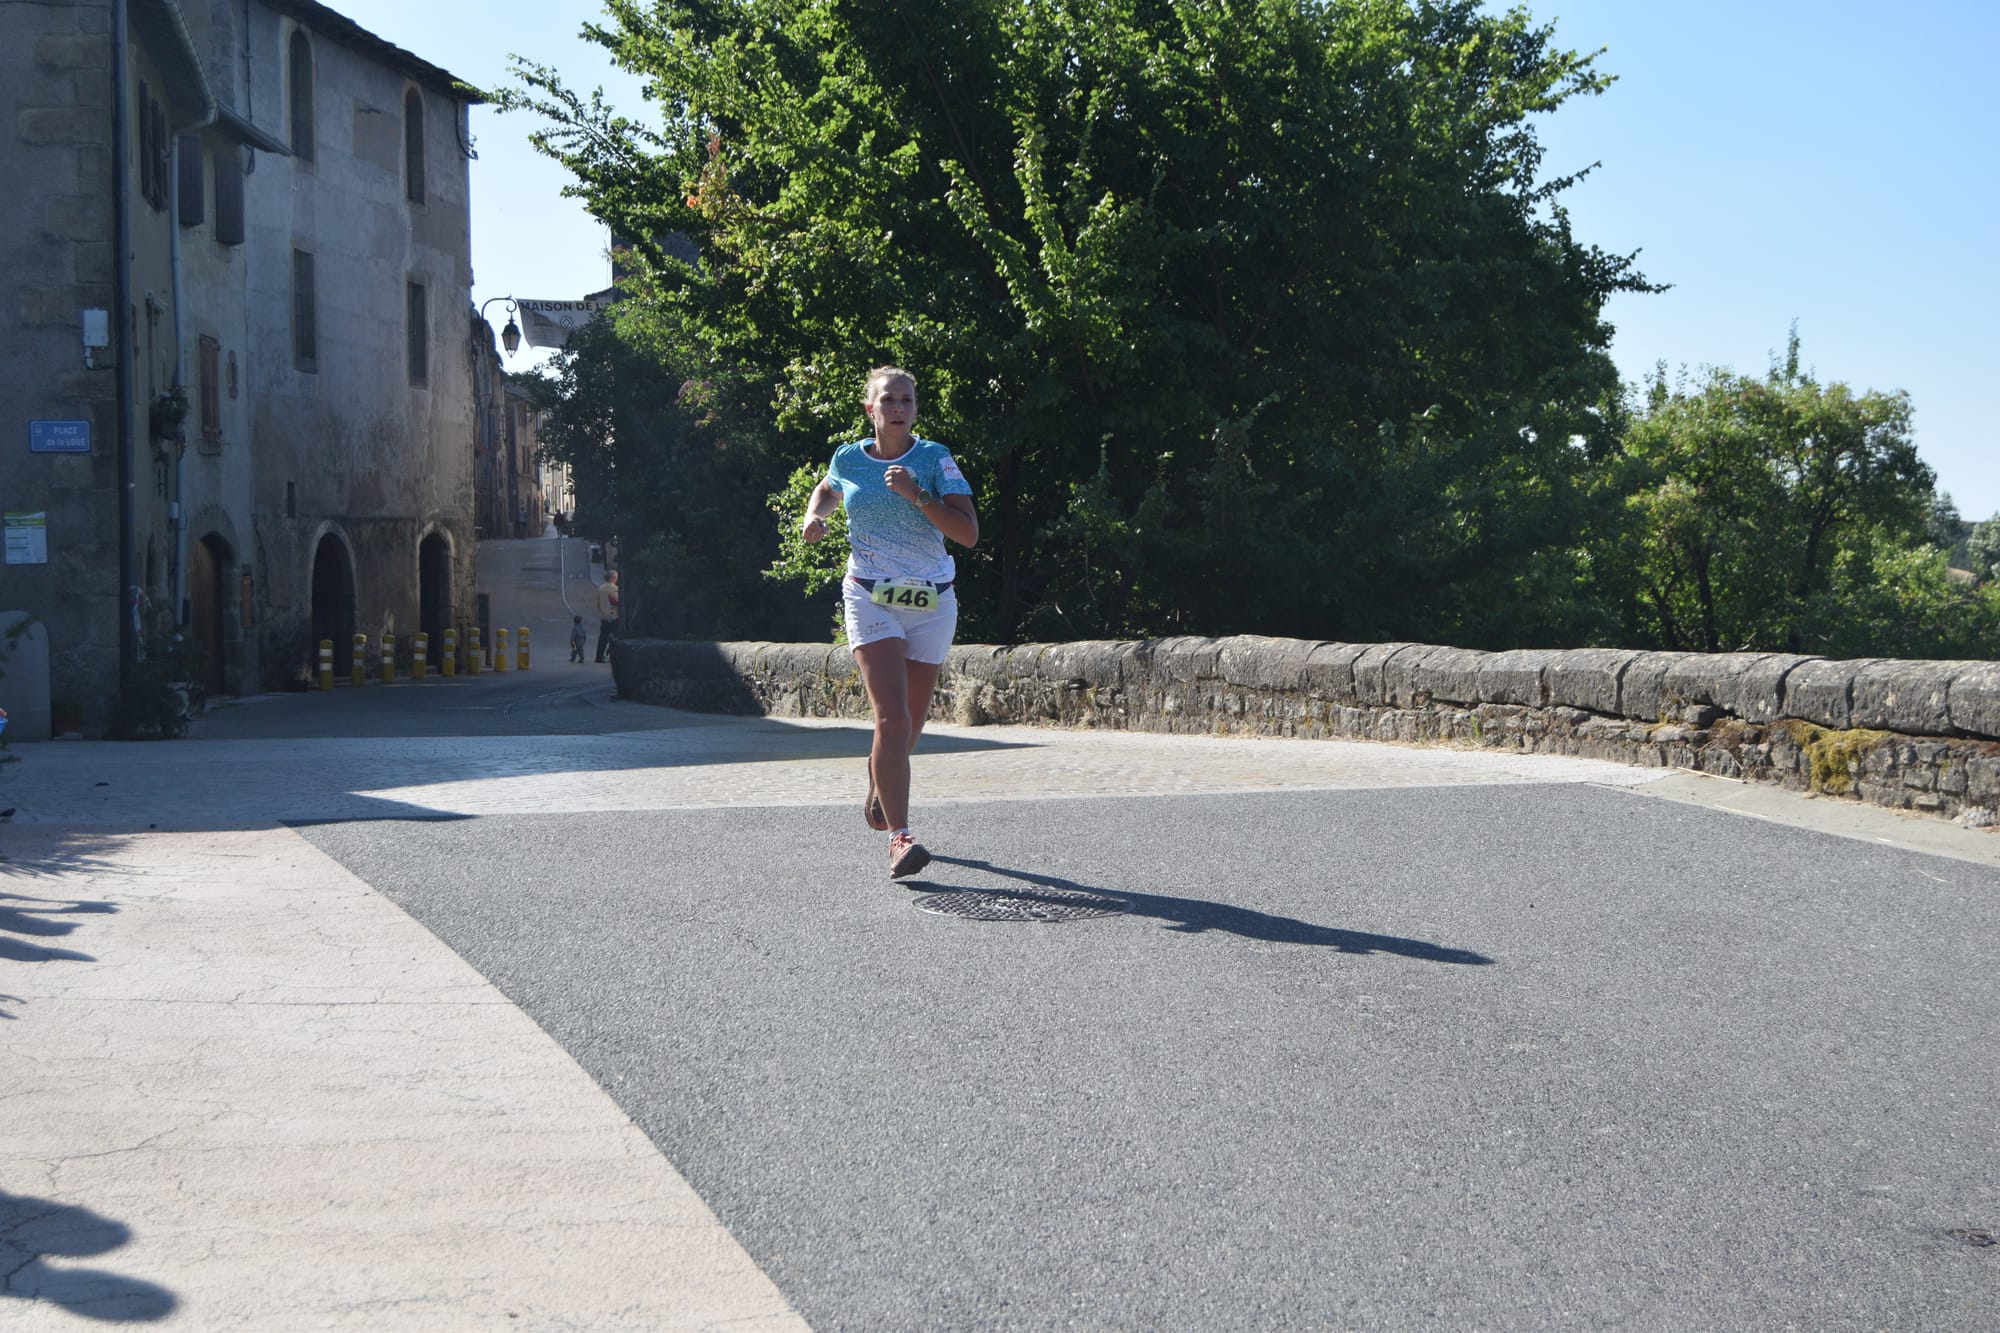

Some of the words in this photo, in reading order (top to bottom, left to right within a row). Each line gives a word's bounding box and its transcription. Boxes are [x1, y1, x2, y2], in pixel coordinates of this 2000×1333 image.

[520, 302, 572, 312] MAISON
[577, 302, 593, 311] DE
[54, 426, 78, 434] PLACE
[883, 587, 929, 607] 146
